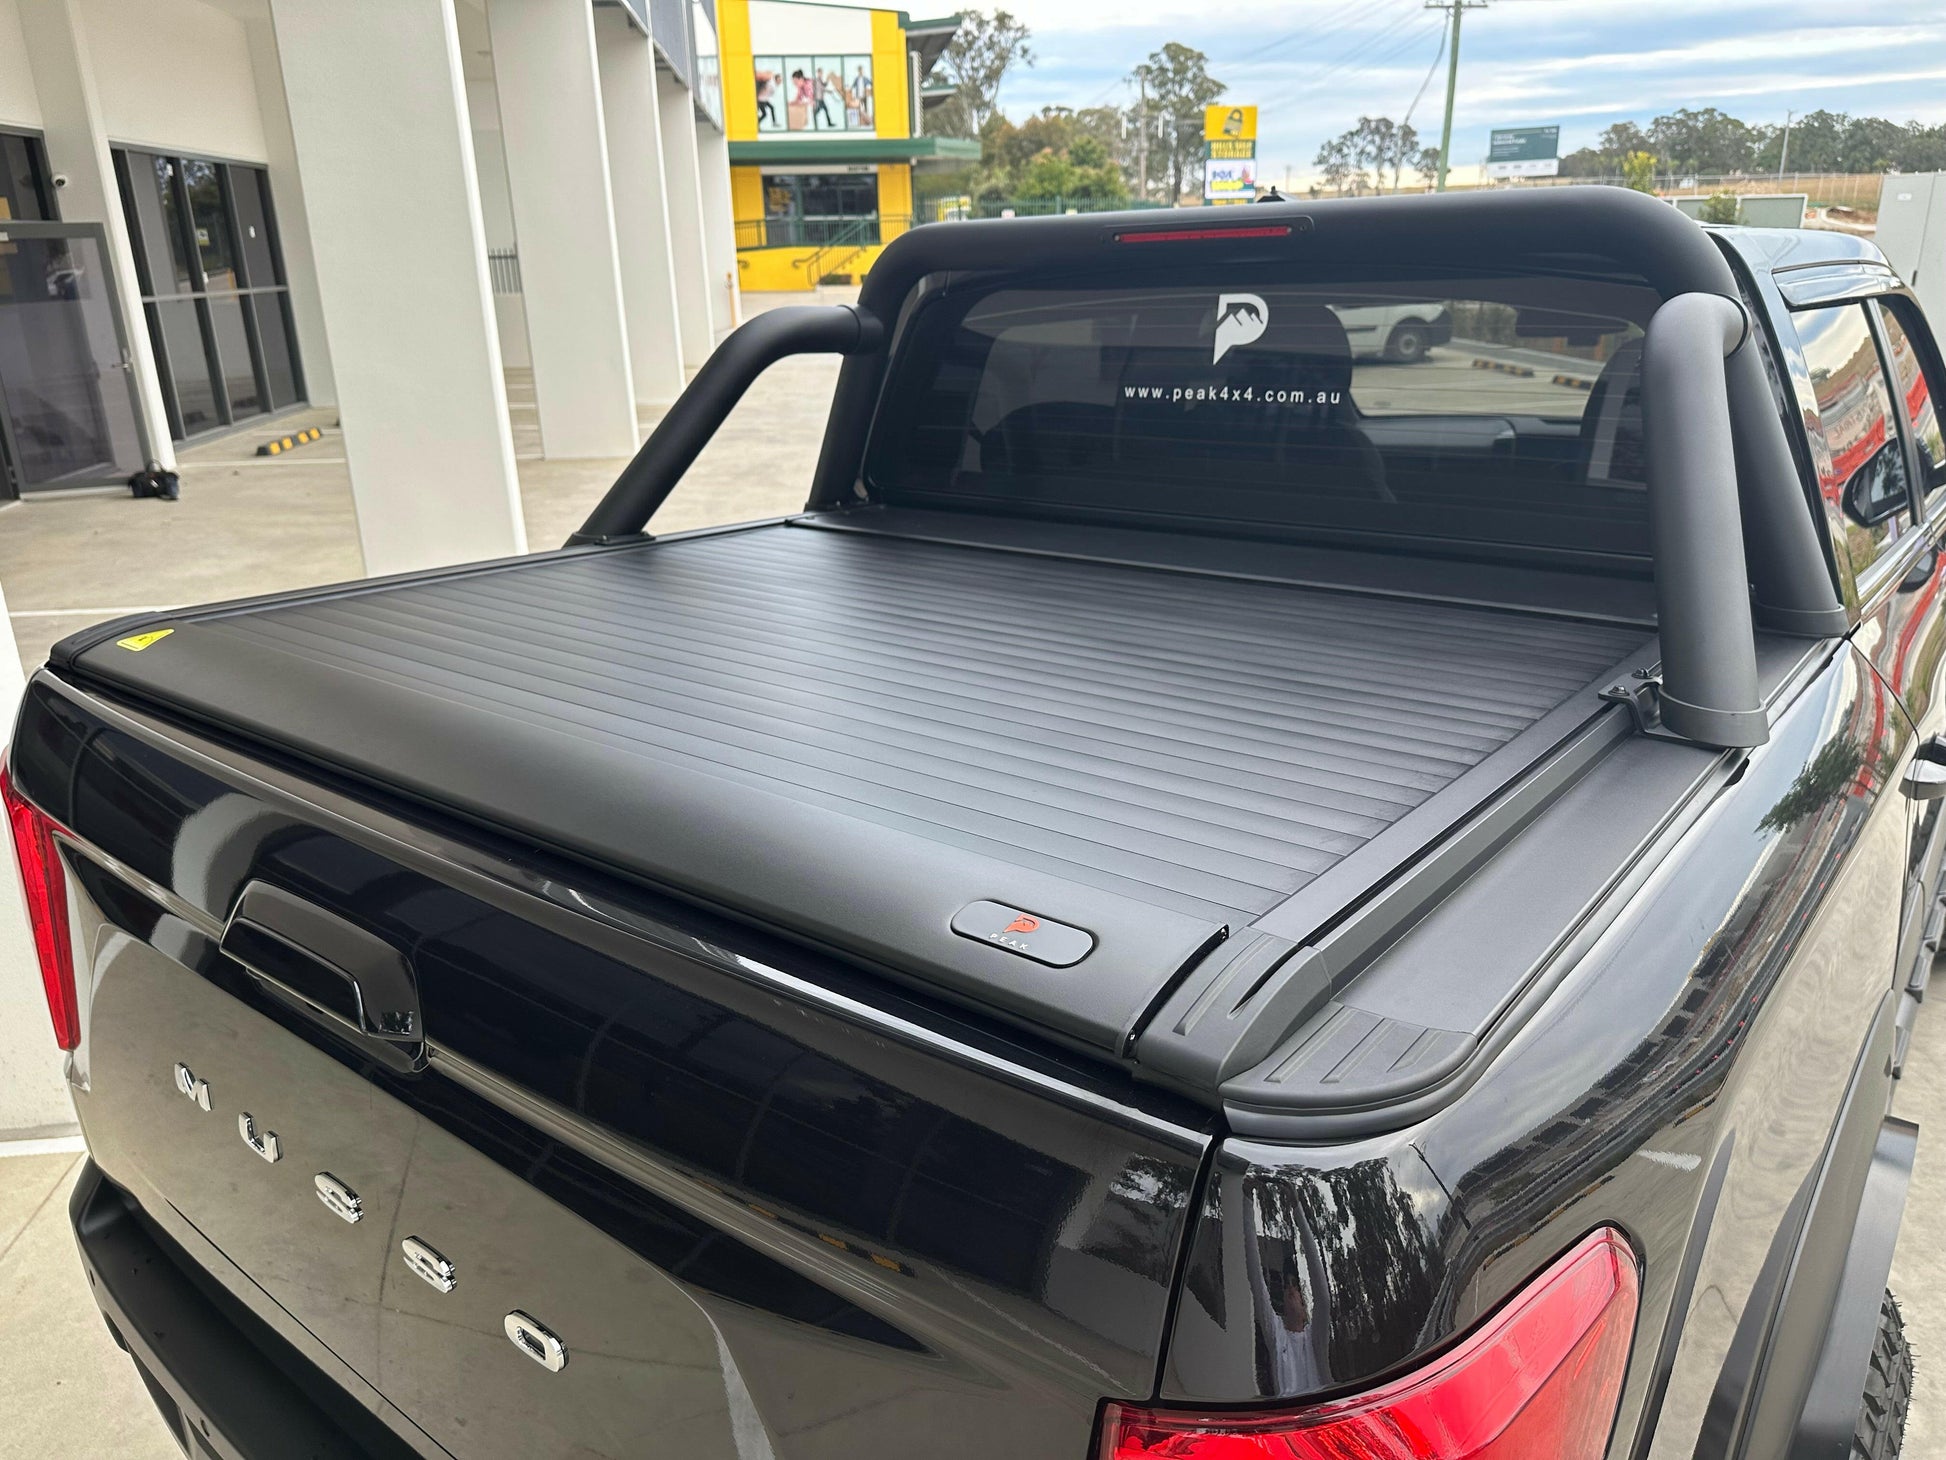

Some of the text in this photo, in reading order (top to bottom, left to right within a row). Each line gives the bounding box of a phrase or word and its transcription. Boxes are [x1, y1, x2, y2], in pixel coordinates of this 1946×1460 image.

[1124, 384, 1341, 404] www.peak4x4.com.au
[989, 933, 1029, 950] PEAK
[173, 1062, 570, 1373] MUSSO
